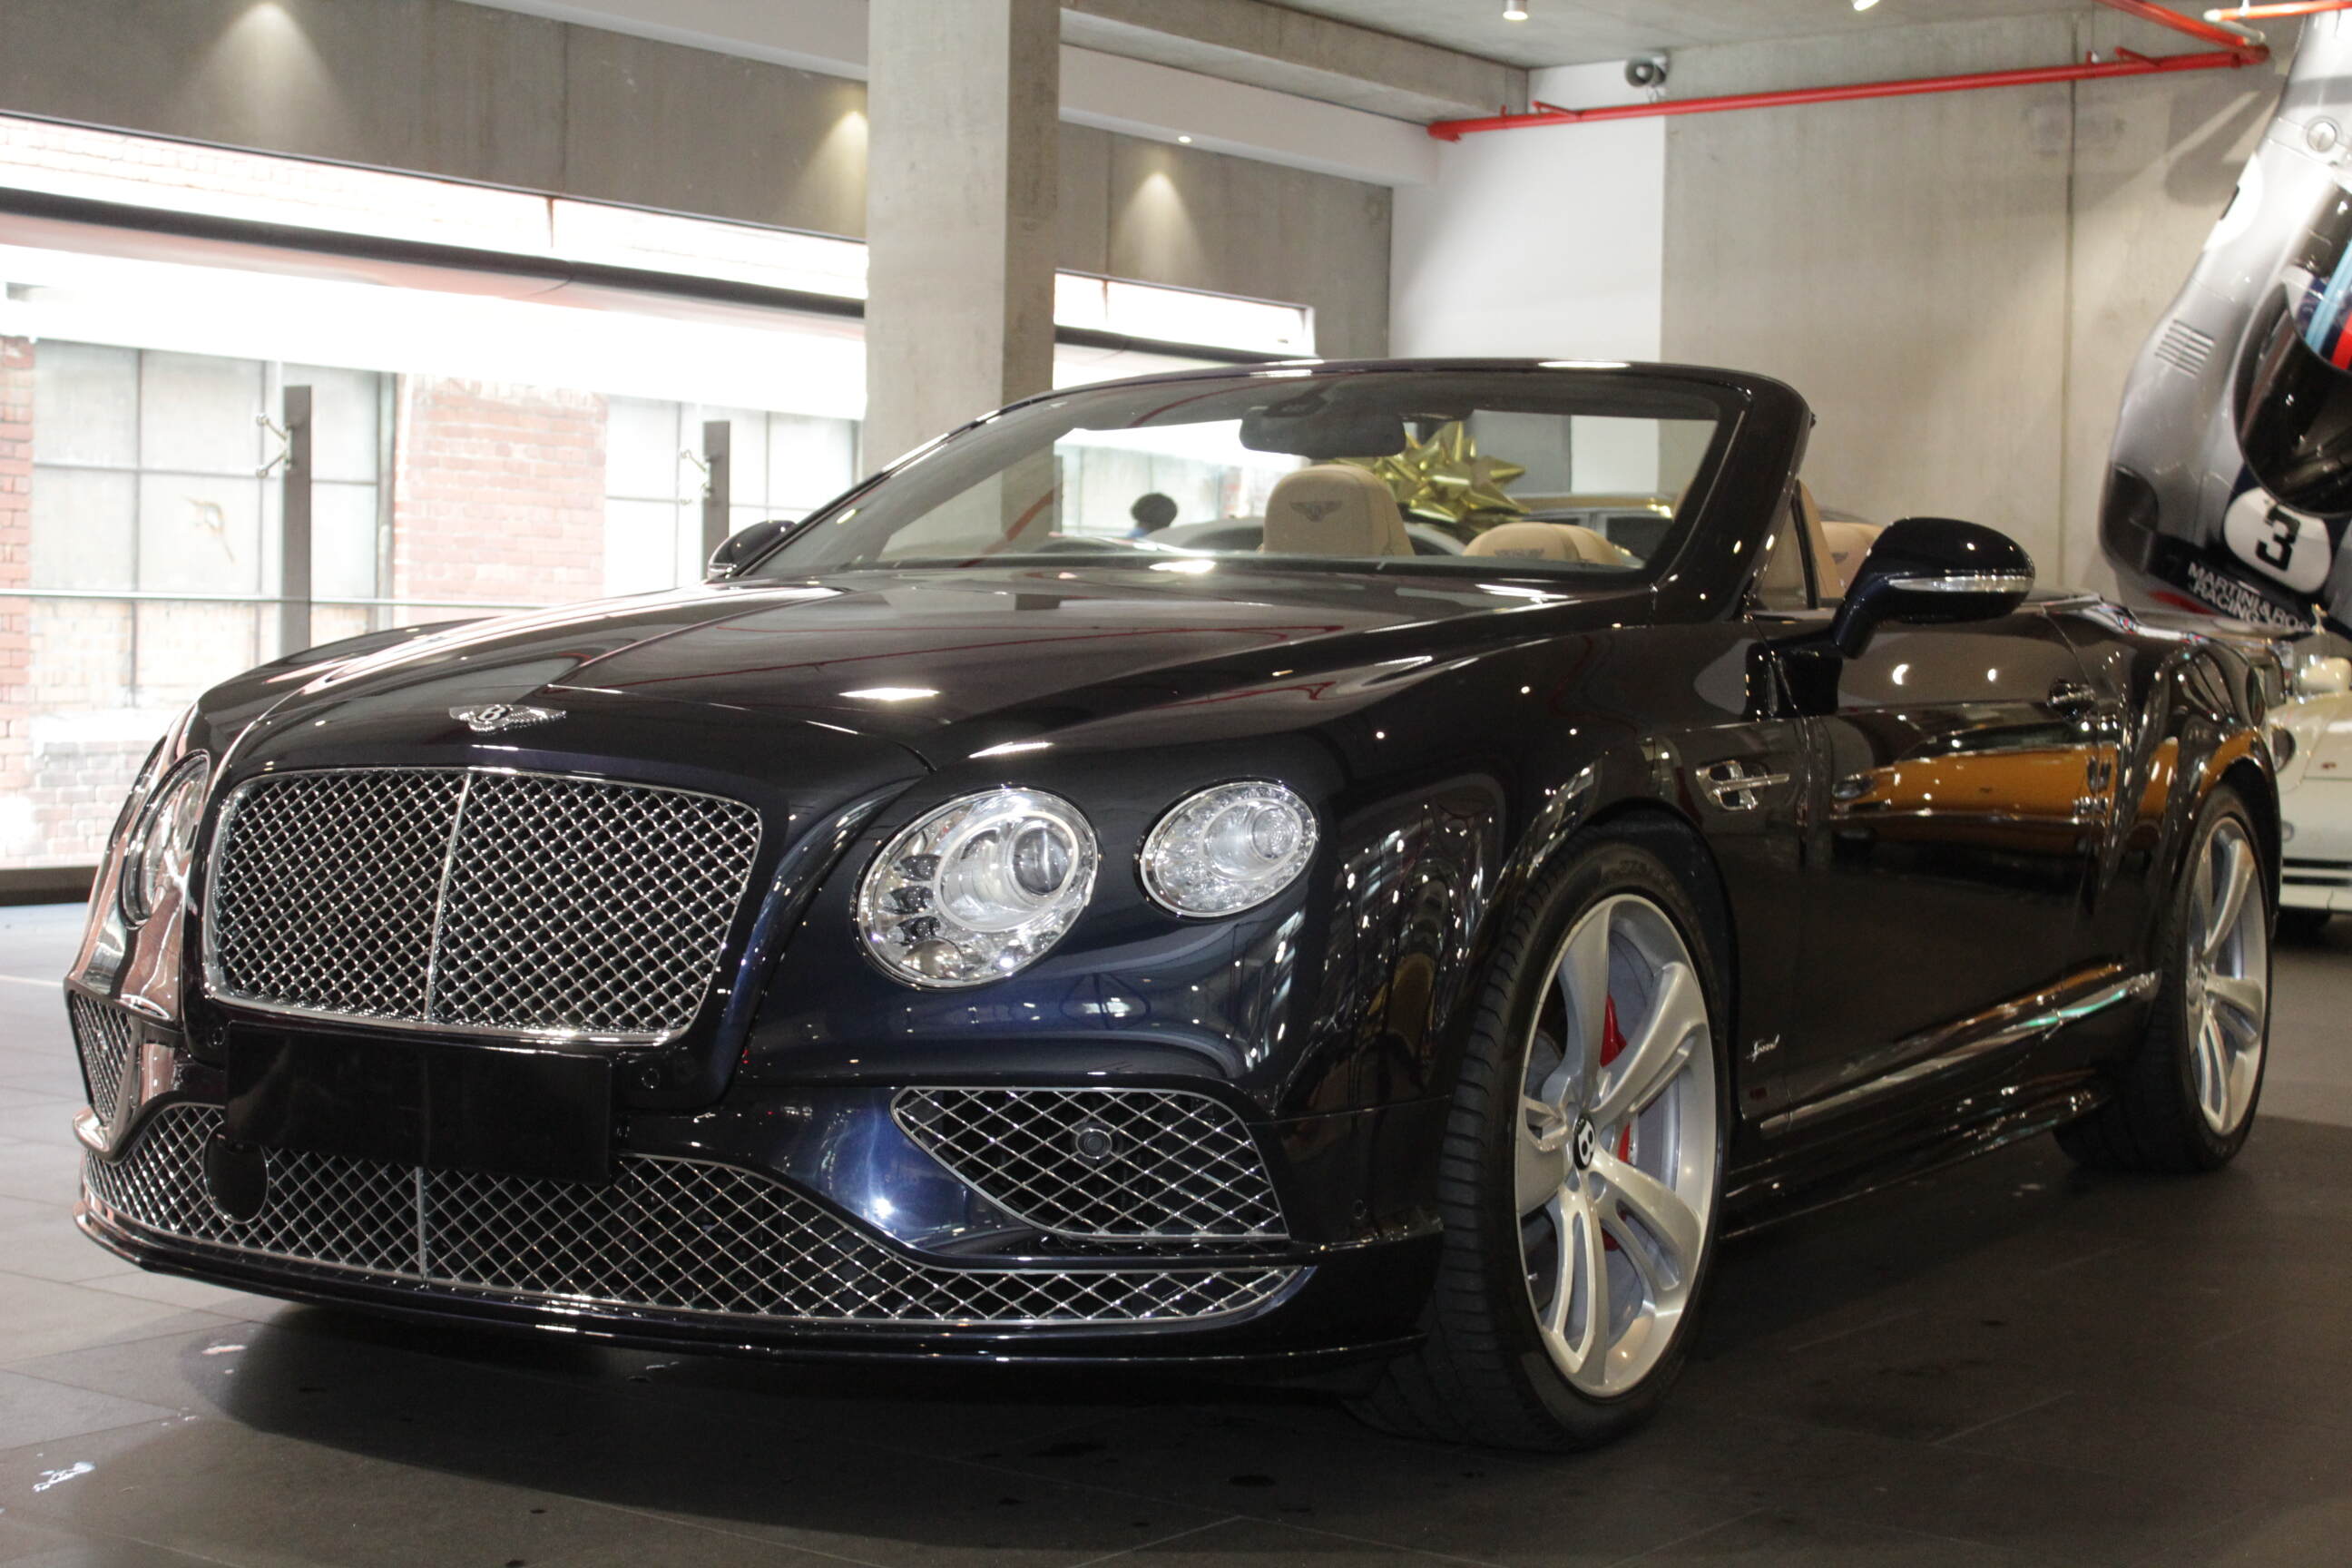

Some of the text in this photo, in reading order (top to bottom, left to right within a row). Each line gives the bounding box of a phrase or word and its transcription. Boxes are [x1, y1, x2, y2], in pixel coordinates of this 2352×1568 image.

[2256, 505, 2300, 571] 3
[2188, 562, 2259, 613] MARTINI
[2190, 581, 2260, 623] RACING
[477, 707, 506, 721] B
[1578, 1120, 1595, 1166] B
